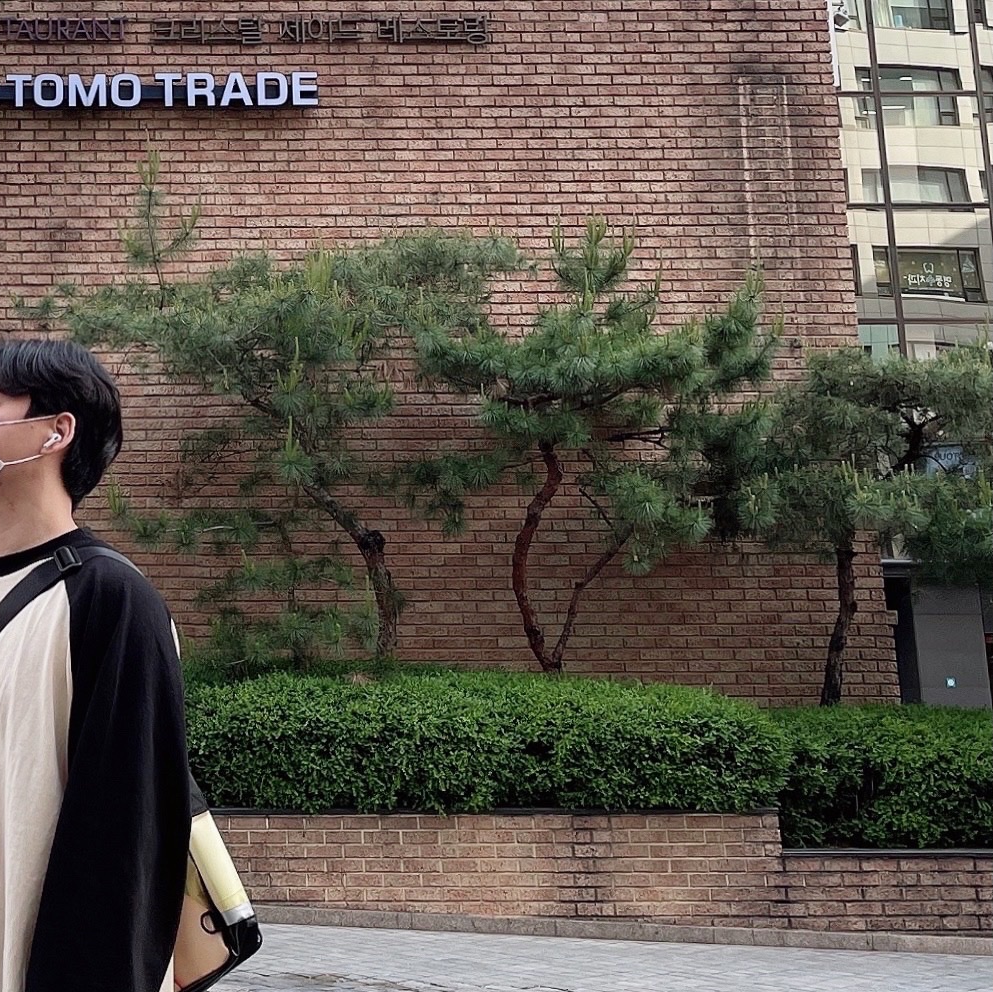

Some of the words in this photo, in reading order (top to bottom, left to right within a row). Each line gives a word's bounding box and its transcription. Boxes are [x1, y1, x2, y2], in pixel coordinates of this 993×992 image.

[150, 16, 264, 45] 크리스탈
[279, 14, 364, 44] 제이드
[376, 13, 490, 45] 레스토랑
[6, 73, 142, 108] TOMO
[155, 71, 319, 107] TRADE
